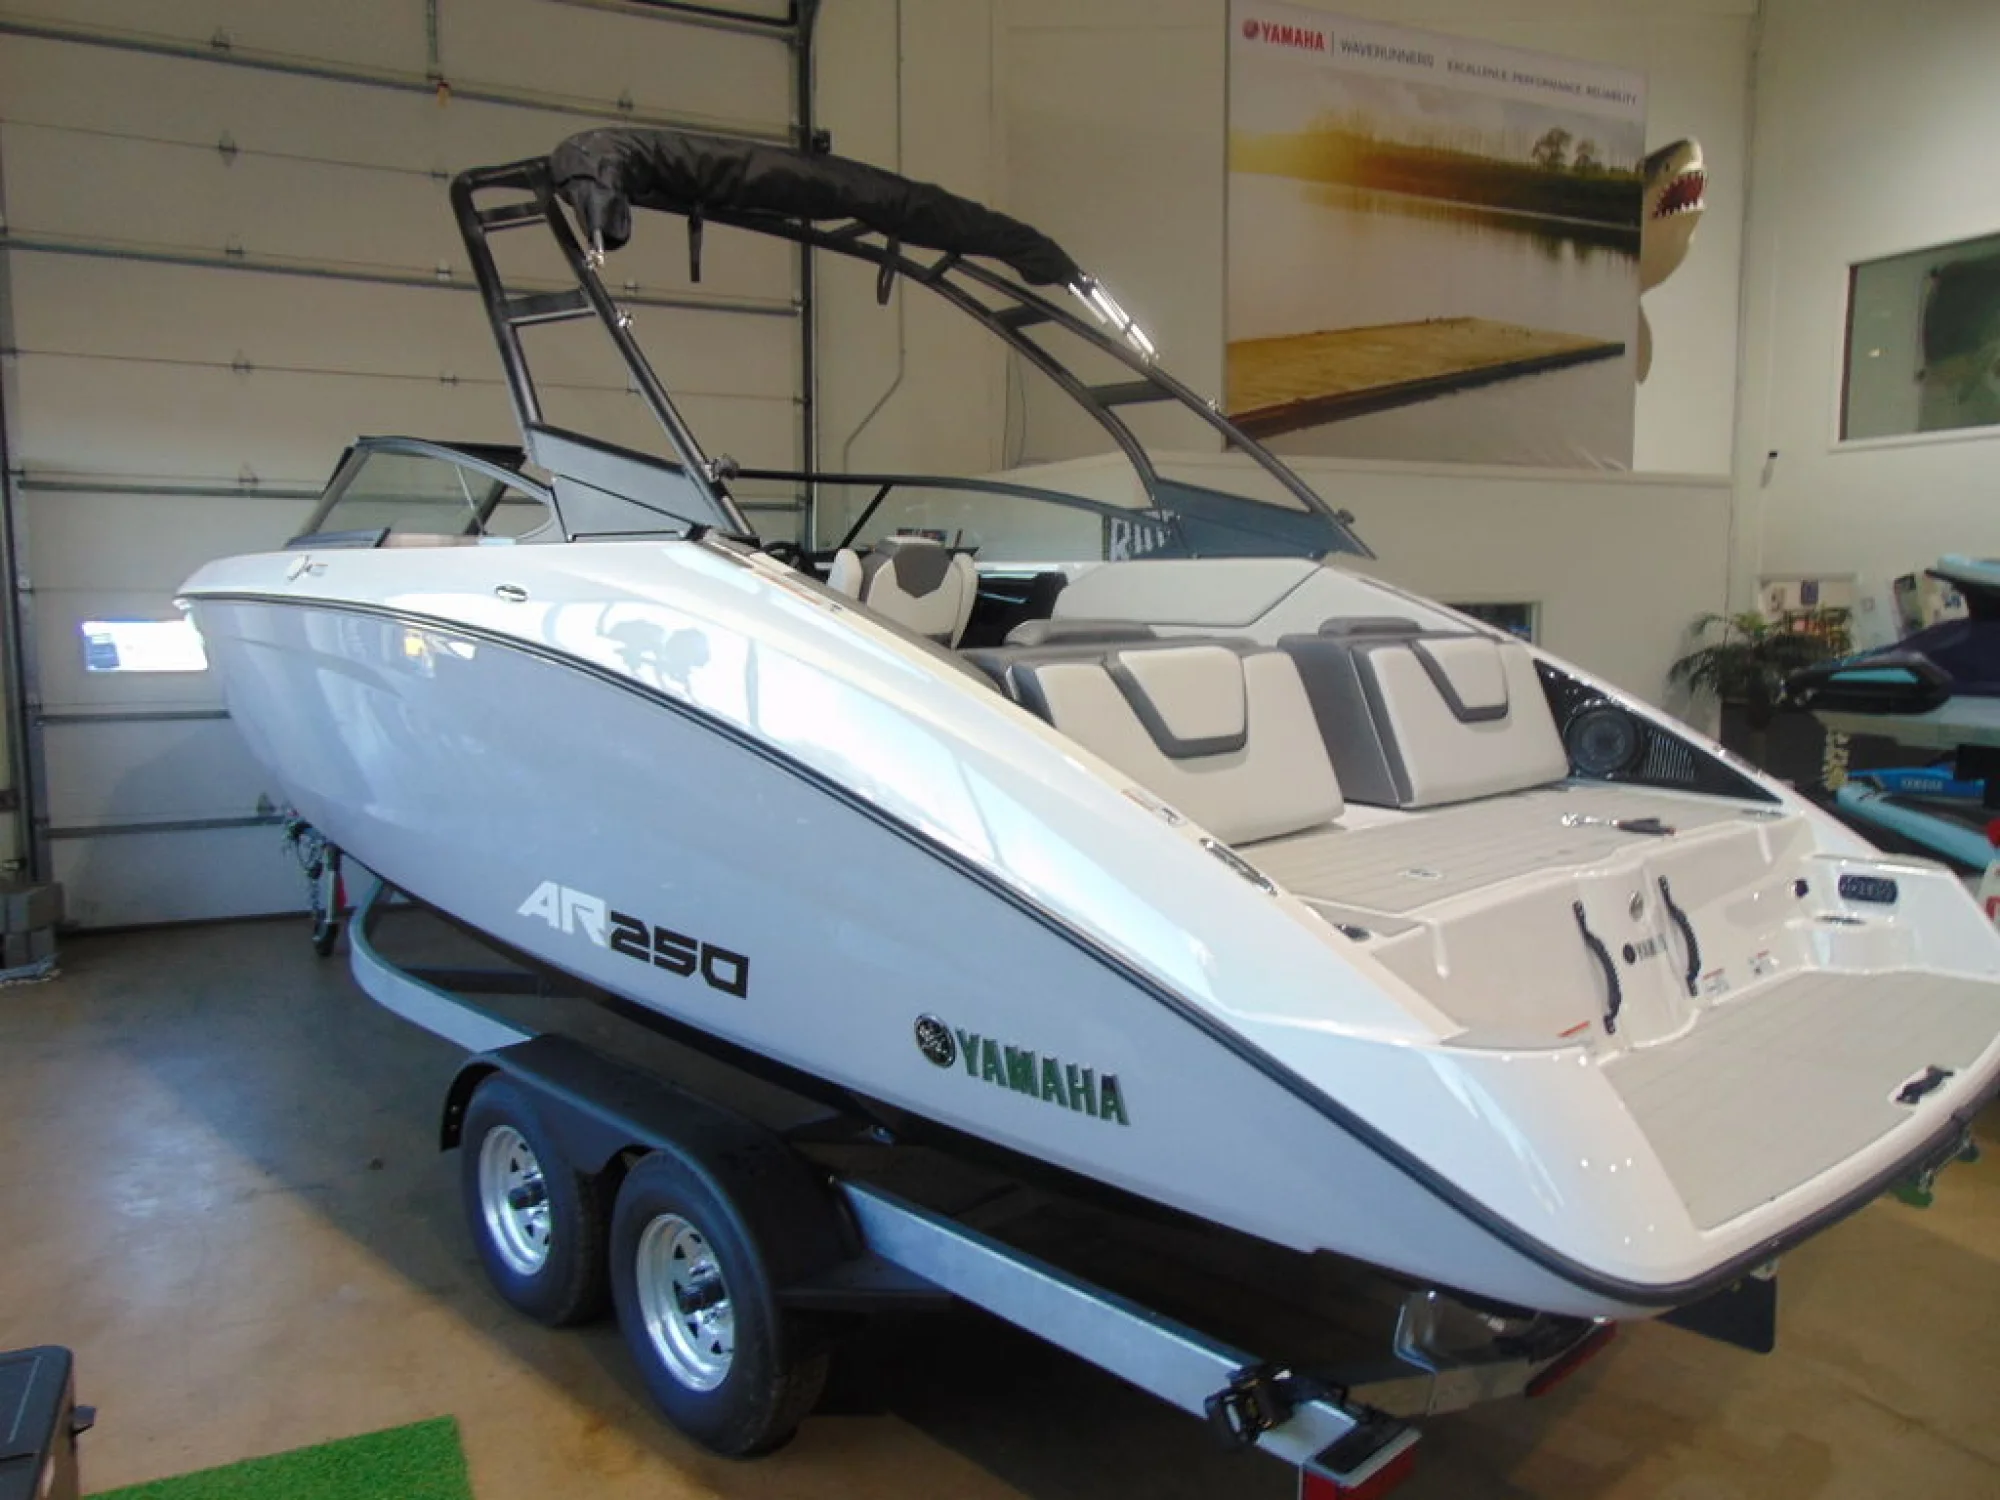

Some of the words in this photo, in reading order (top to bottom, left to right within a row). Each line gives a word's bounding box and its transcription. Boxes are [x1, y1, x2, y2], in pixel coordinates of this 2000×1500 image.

[1261, 20, 1326, 52] YAMAHA
[1339, 37, 1435, 68] WAVERUNNERS
[954, 1025, 1130, 1126] YAMAHA
